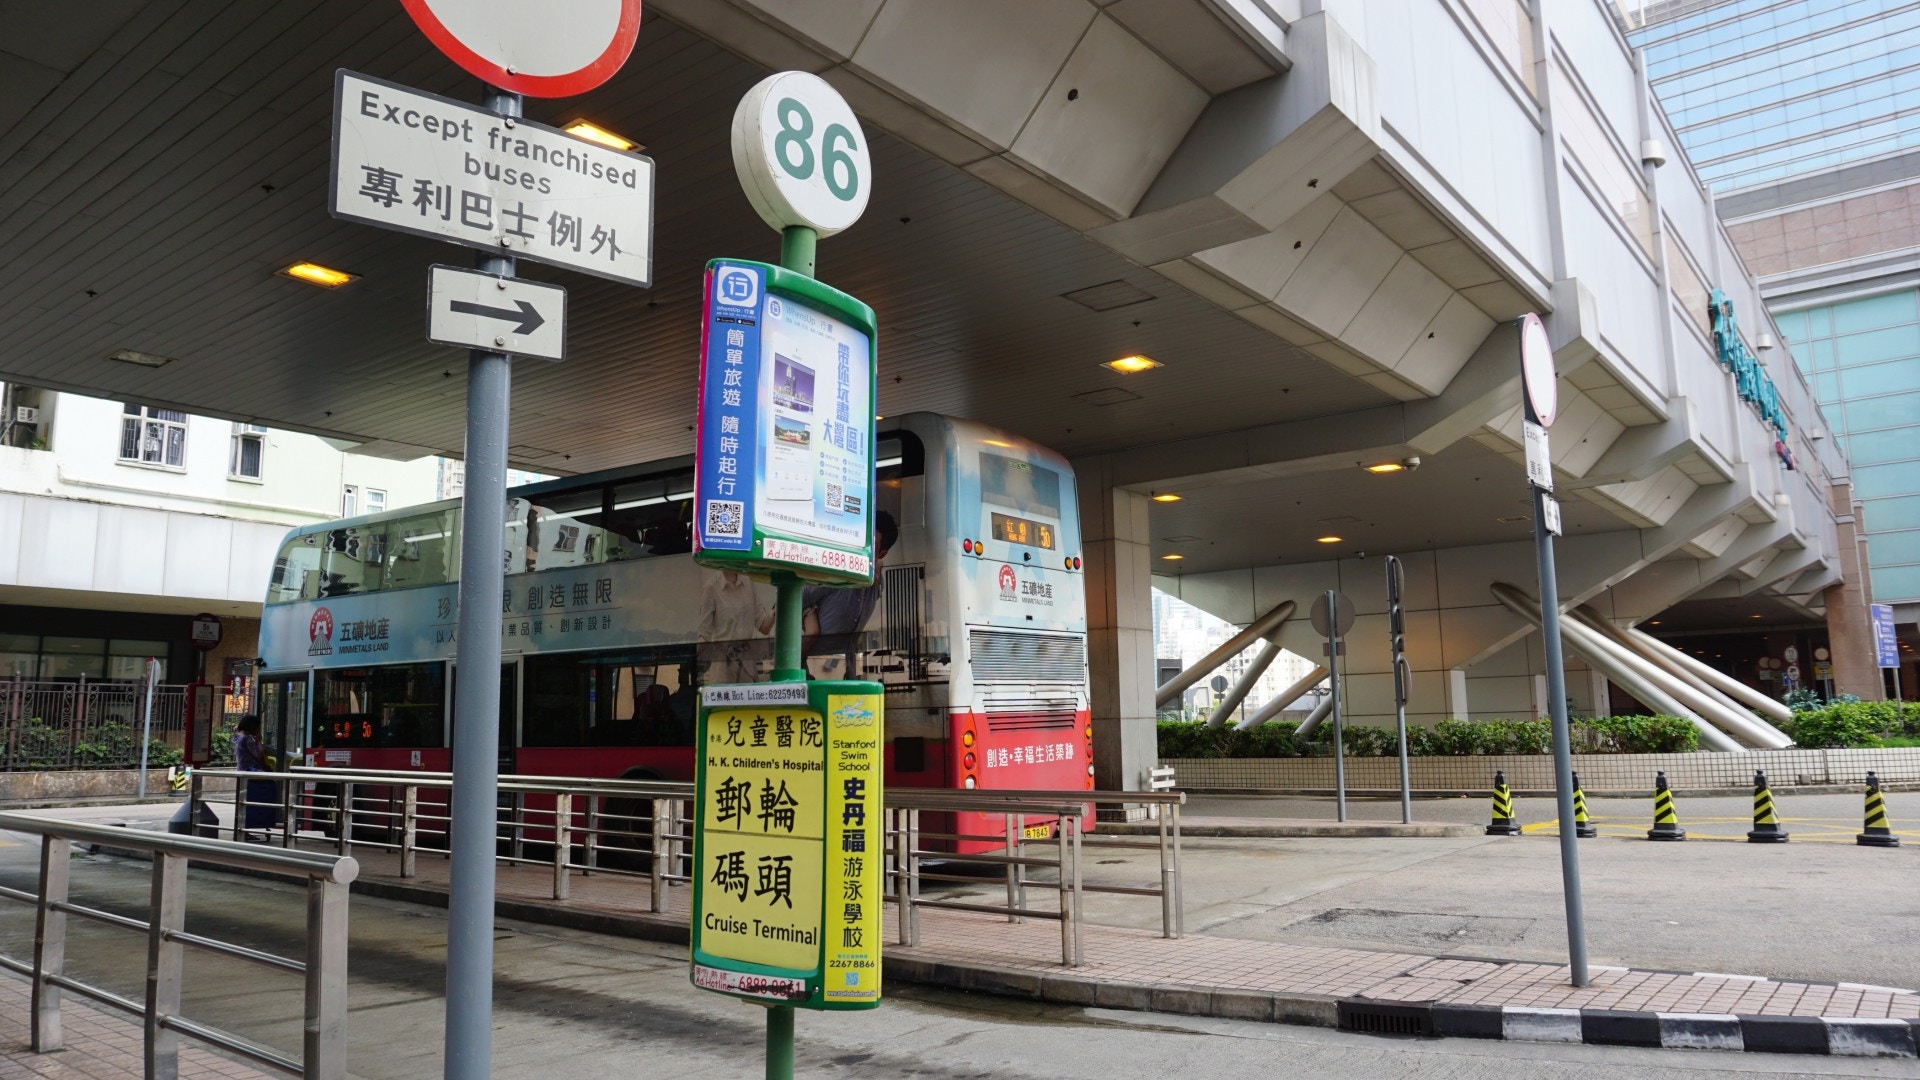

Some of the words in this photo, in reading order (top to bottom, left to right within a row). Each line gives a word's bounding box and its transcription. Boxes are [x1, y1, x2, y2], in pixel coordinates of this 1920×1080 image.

[360, 90, 473, 143] Except
[488, 127, 637, 189] franchised
[775, 97, 858, 202] 86
[464, 152, 551, 194] buses
[359, 164, 622, 261] 專利巴士例外
[722, 328, 744, 407] 簡單旅遊
[717, 415, 739, 496] 隨時起行
[767, 549, 780, 558] Ad
[528, 578, 612, 610] 創造無限
[339, 643, 372, 655] MINMETALS
[373, 642, 389, 652] LAND
[732, 690, 744, 701] Hot
[833, 739, 876, 749] Stanford
[841, 751, 867, 760] Swim
[708, 757, 718, 767] H.
[720, 757, 730, 768] K.
[732, 757, 780, 769] Children's
[782, 759, 824, 773] Hospital
[838, 762, 870, 771] School
[715, 776, 799, 833] 郵輪
[711, 850, 793, 909] 碼頭
[705, 912, 748, 935] Cruise
[753, 919, 817, 946] Terminal
[830, 960, 851, 968] 2267
[853, 960, 875, 968] 8866
